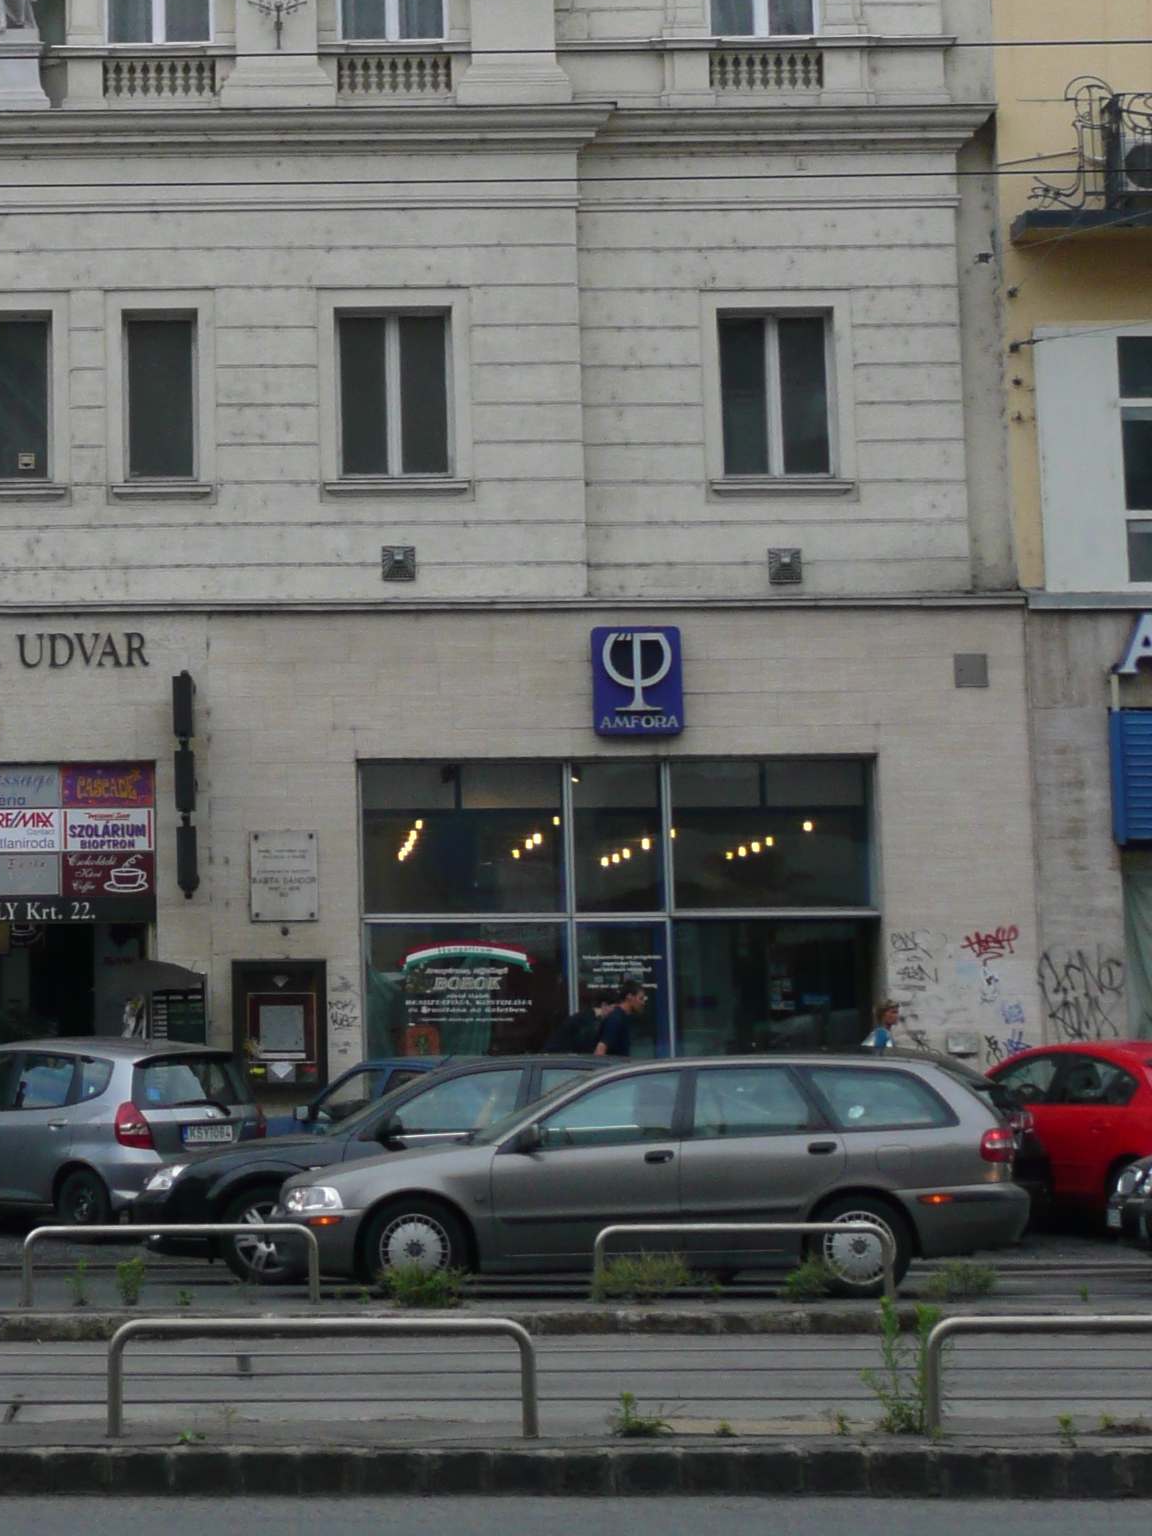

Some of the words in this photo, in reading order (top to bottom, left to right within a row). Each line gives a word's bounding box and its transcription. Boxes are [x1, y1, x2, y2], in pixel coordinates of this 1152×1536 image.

[15, 632, 150, 669] UDVAR
[600, 715, 679, 729] AMFORA
[76, 776, 138, 800] CASCADE
[26, 828, 55, 836] Contact
[69, 821, 147, 838] SZOLÁRIUM
[80, 839, 136, 850] BIOPTRON
[26, 902, 64, 920] Krt.
[70, 901, 97, 920] 22.
[432, 976, 503, 991] BOROK
